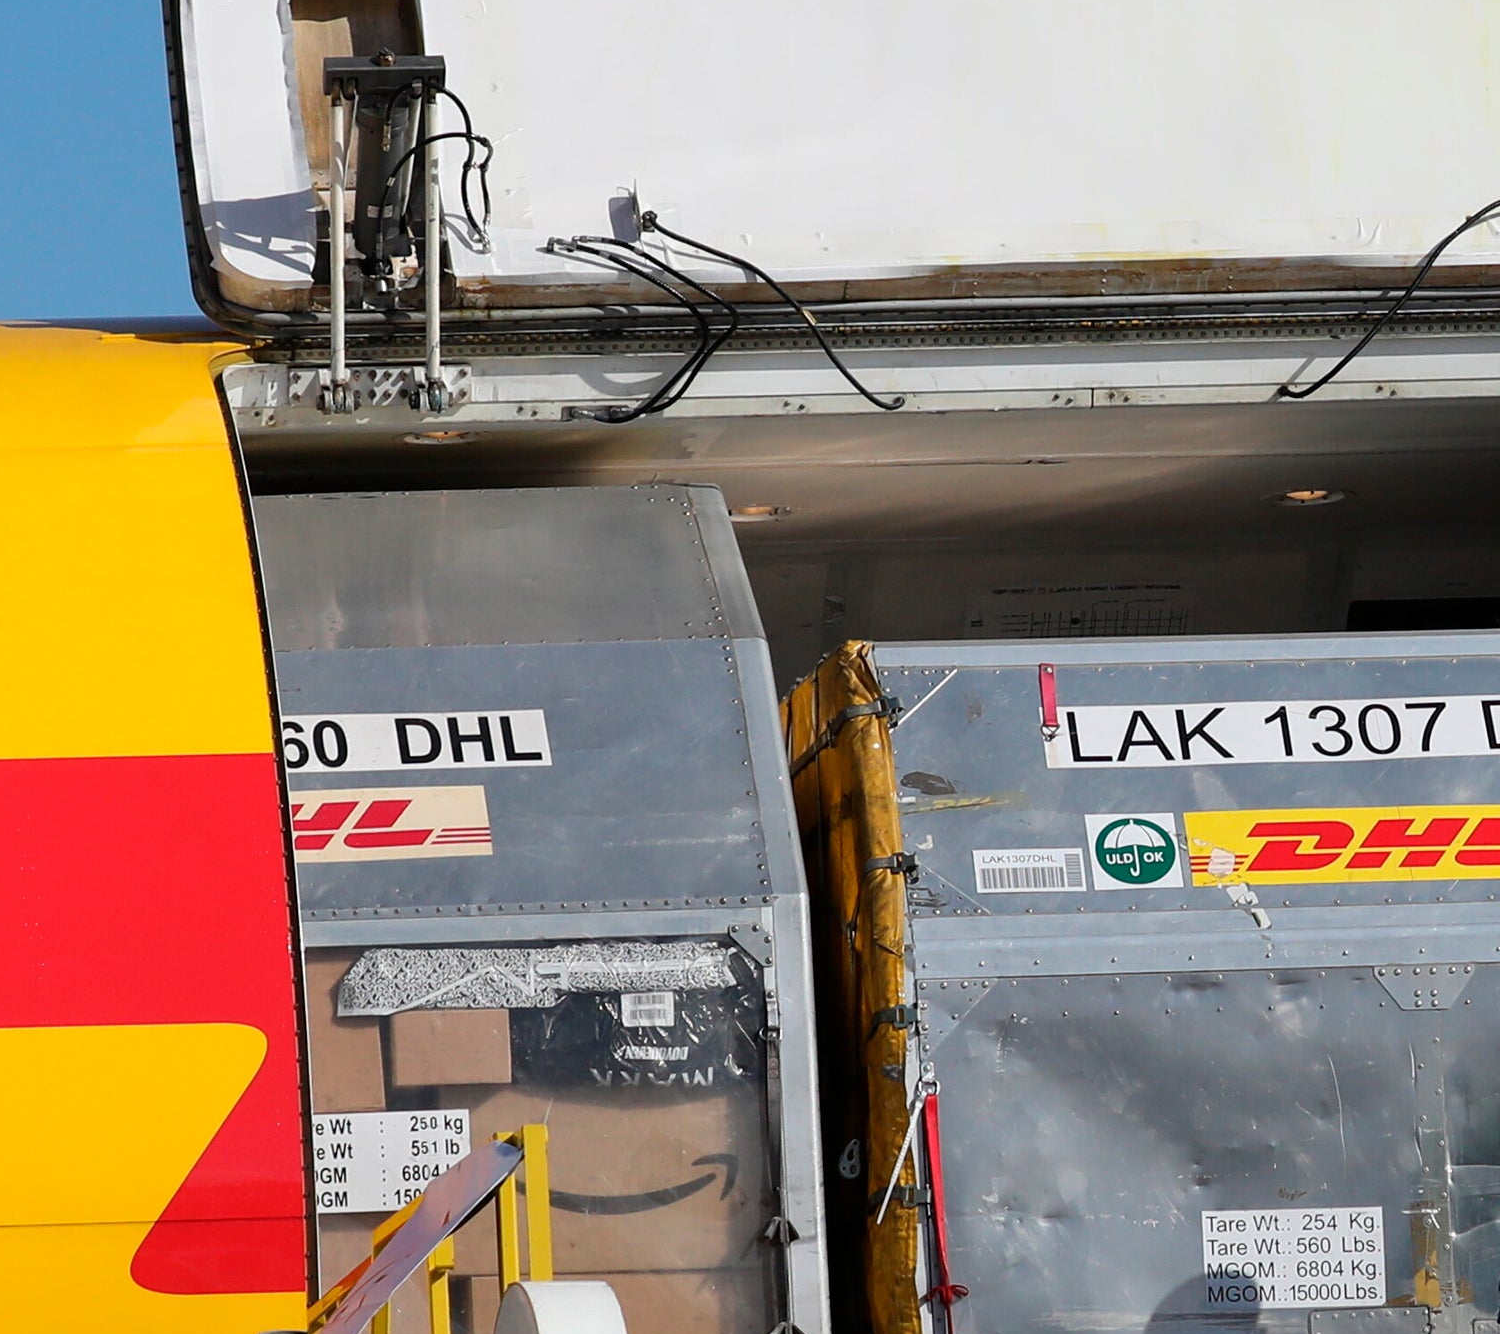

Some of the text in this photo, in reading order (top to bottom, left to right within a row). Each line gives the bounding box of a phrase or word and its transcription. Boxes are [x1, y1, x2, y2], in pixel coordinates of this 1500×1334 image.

[394, 715, 543, 765] DHL
[1065, 706, 1234, 763] LAK
[1264, 702, 1447, 757] 1307
[981, 854, 1057, 865] LAK1307DHL
[1105, 851, 1165, 865] ULD OK
[329, 1118, 352, 1135] Wt
[409, 1116, 438, 1132] 250
[444, 1115, 463, 1135] kg
[330, 1143, 353, 1159] Wt
[411, 1140, 438, 1157] 551
[445, 1139, 460, 1155] lb
[402, 1164, 440, 1182] 6804
[1206, 1216, 1247, 1233] Tare
[1302, 1214, 1338, 1231] 254
[1349, 1213, 1381, 1234] Kg.
[1207, 1239, 1248, 1256] Tare
[1296, 1237, 1331, 1254] 560
[1342, 1236, 1382, 1254] Lbs.
[1296, 1260, 1344, 1278] 6804
[1351, 1259, 1383, 1280] Kg.
